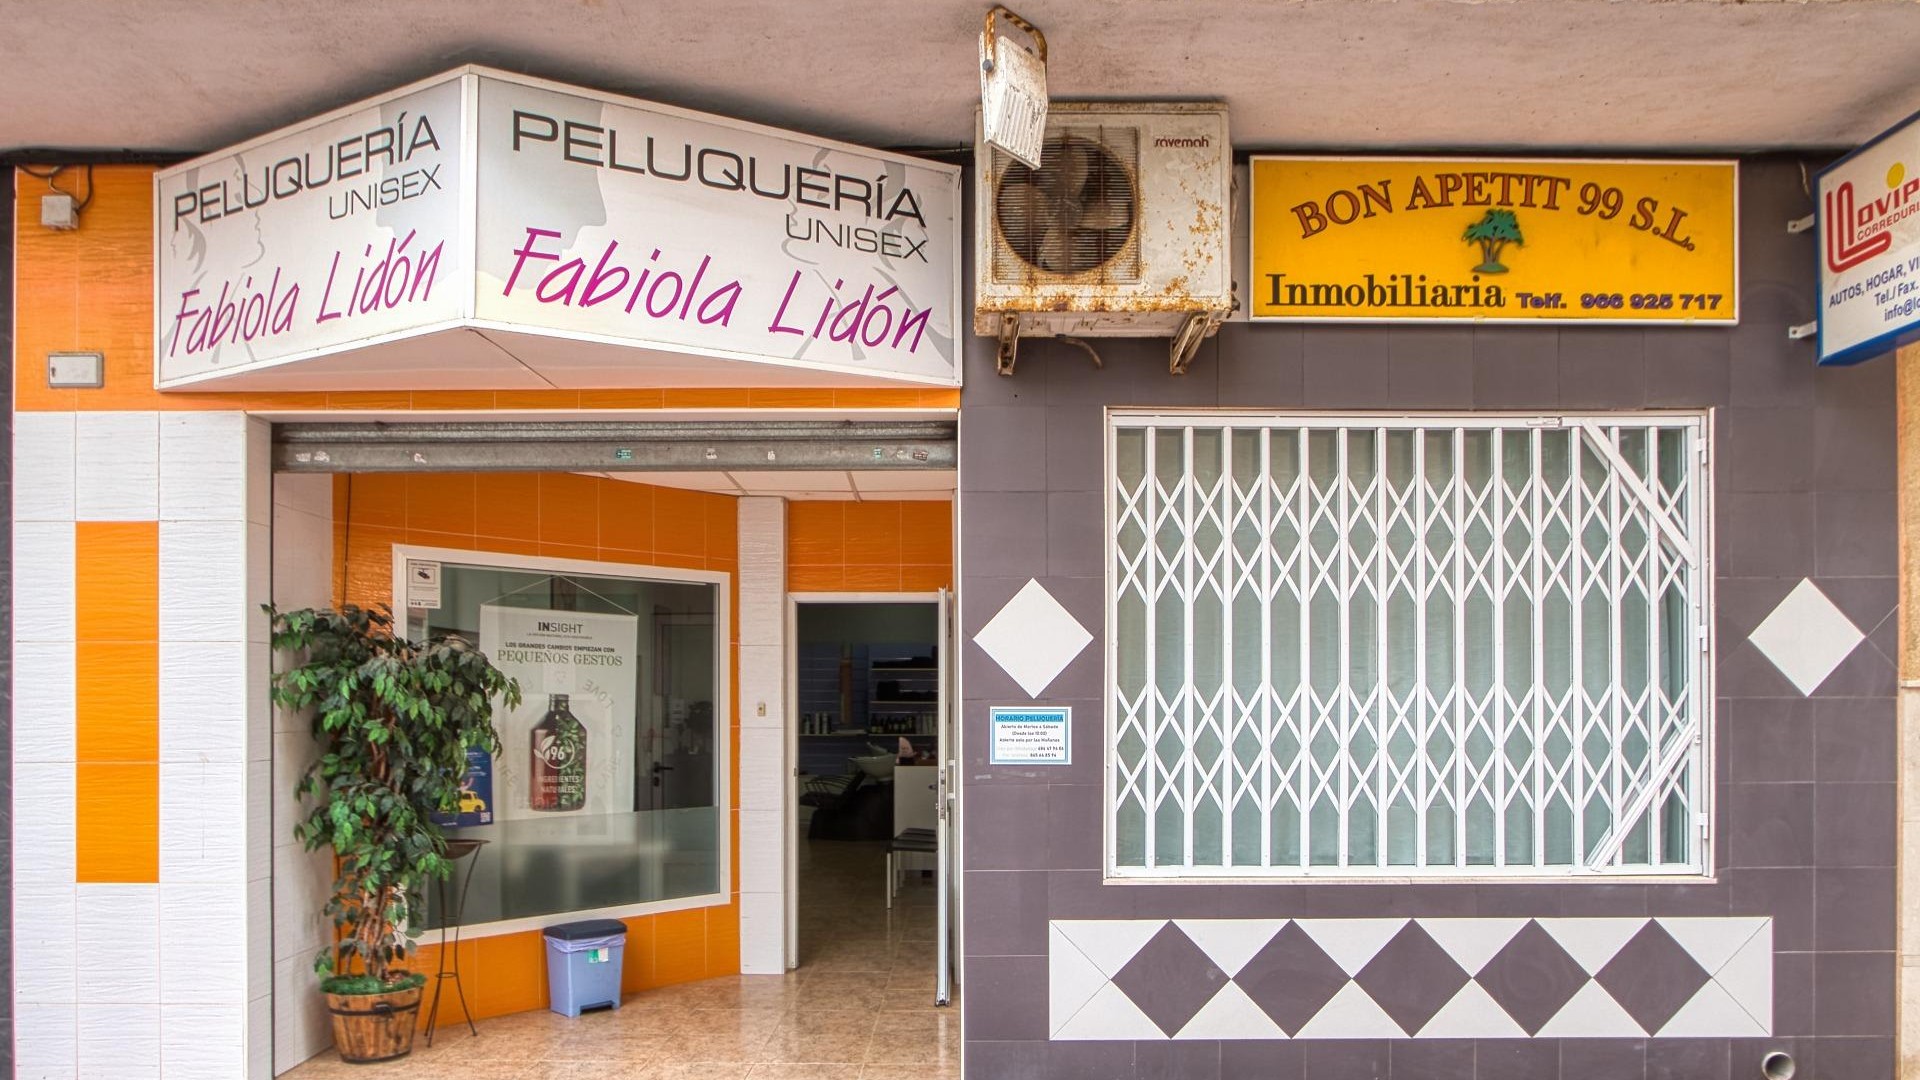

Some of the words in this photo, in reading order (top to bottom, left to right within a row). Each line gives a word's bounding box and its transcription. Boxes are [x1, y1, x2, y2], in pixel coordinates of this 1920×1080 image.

[174, 111, 441, 231] PELUQUERÍA
[329, 164, 442, 220] UNISEX
[512, 110, 927, 228] PELUQUERÍA
[786, 214, 929, 263] UNISEX
[1290, 179, 1393, 239] BON
[1405, 172, 1571, 211] APETIT
[1577, 182, 1624, 221] 99
[1629, 197, 1696, 252] S.L.
[316, 228, 445, 325] Lidón
[502, 227, 743, 327] Fabiola
[1265, 273, 1506, 308] Inmobiliaria
[1516, 292, 1567, 309] Telf.
[1580, 293, 1624, 309] 966
[1630, 293, 1673, 309] 925
[1679, 293, 1723, 310] 717
[1829, 283, 1865, 308] AUTOS,
[1866, 264, 1907, 291] HOGAR,
[170, 267, 300, 358] Fabiola
[768, 270, 932, 353] Lidón
[497, 649, 569, 664] PEQUEÑOS
[573, 653, 623, 667] GESTOS
[538, 622, 584, 634] INSIGHT
[996, 714, 1025, 722] HORARIO
